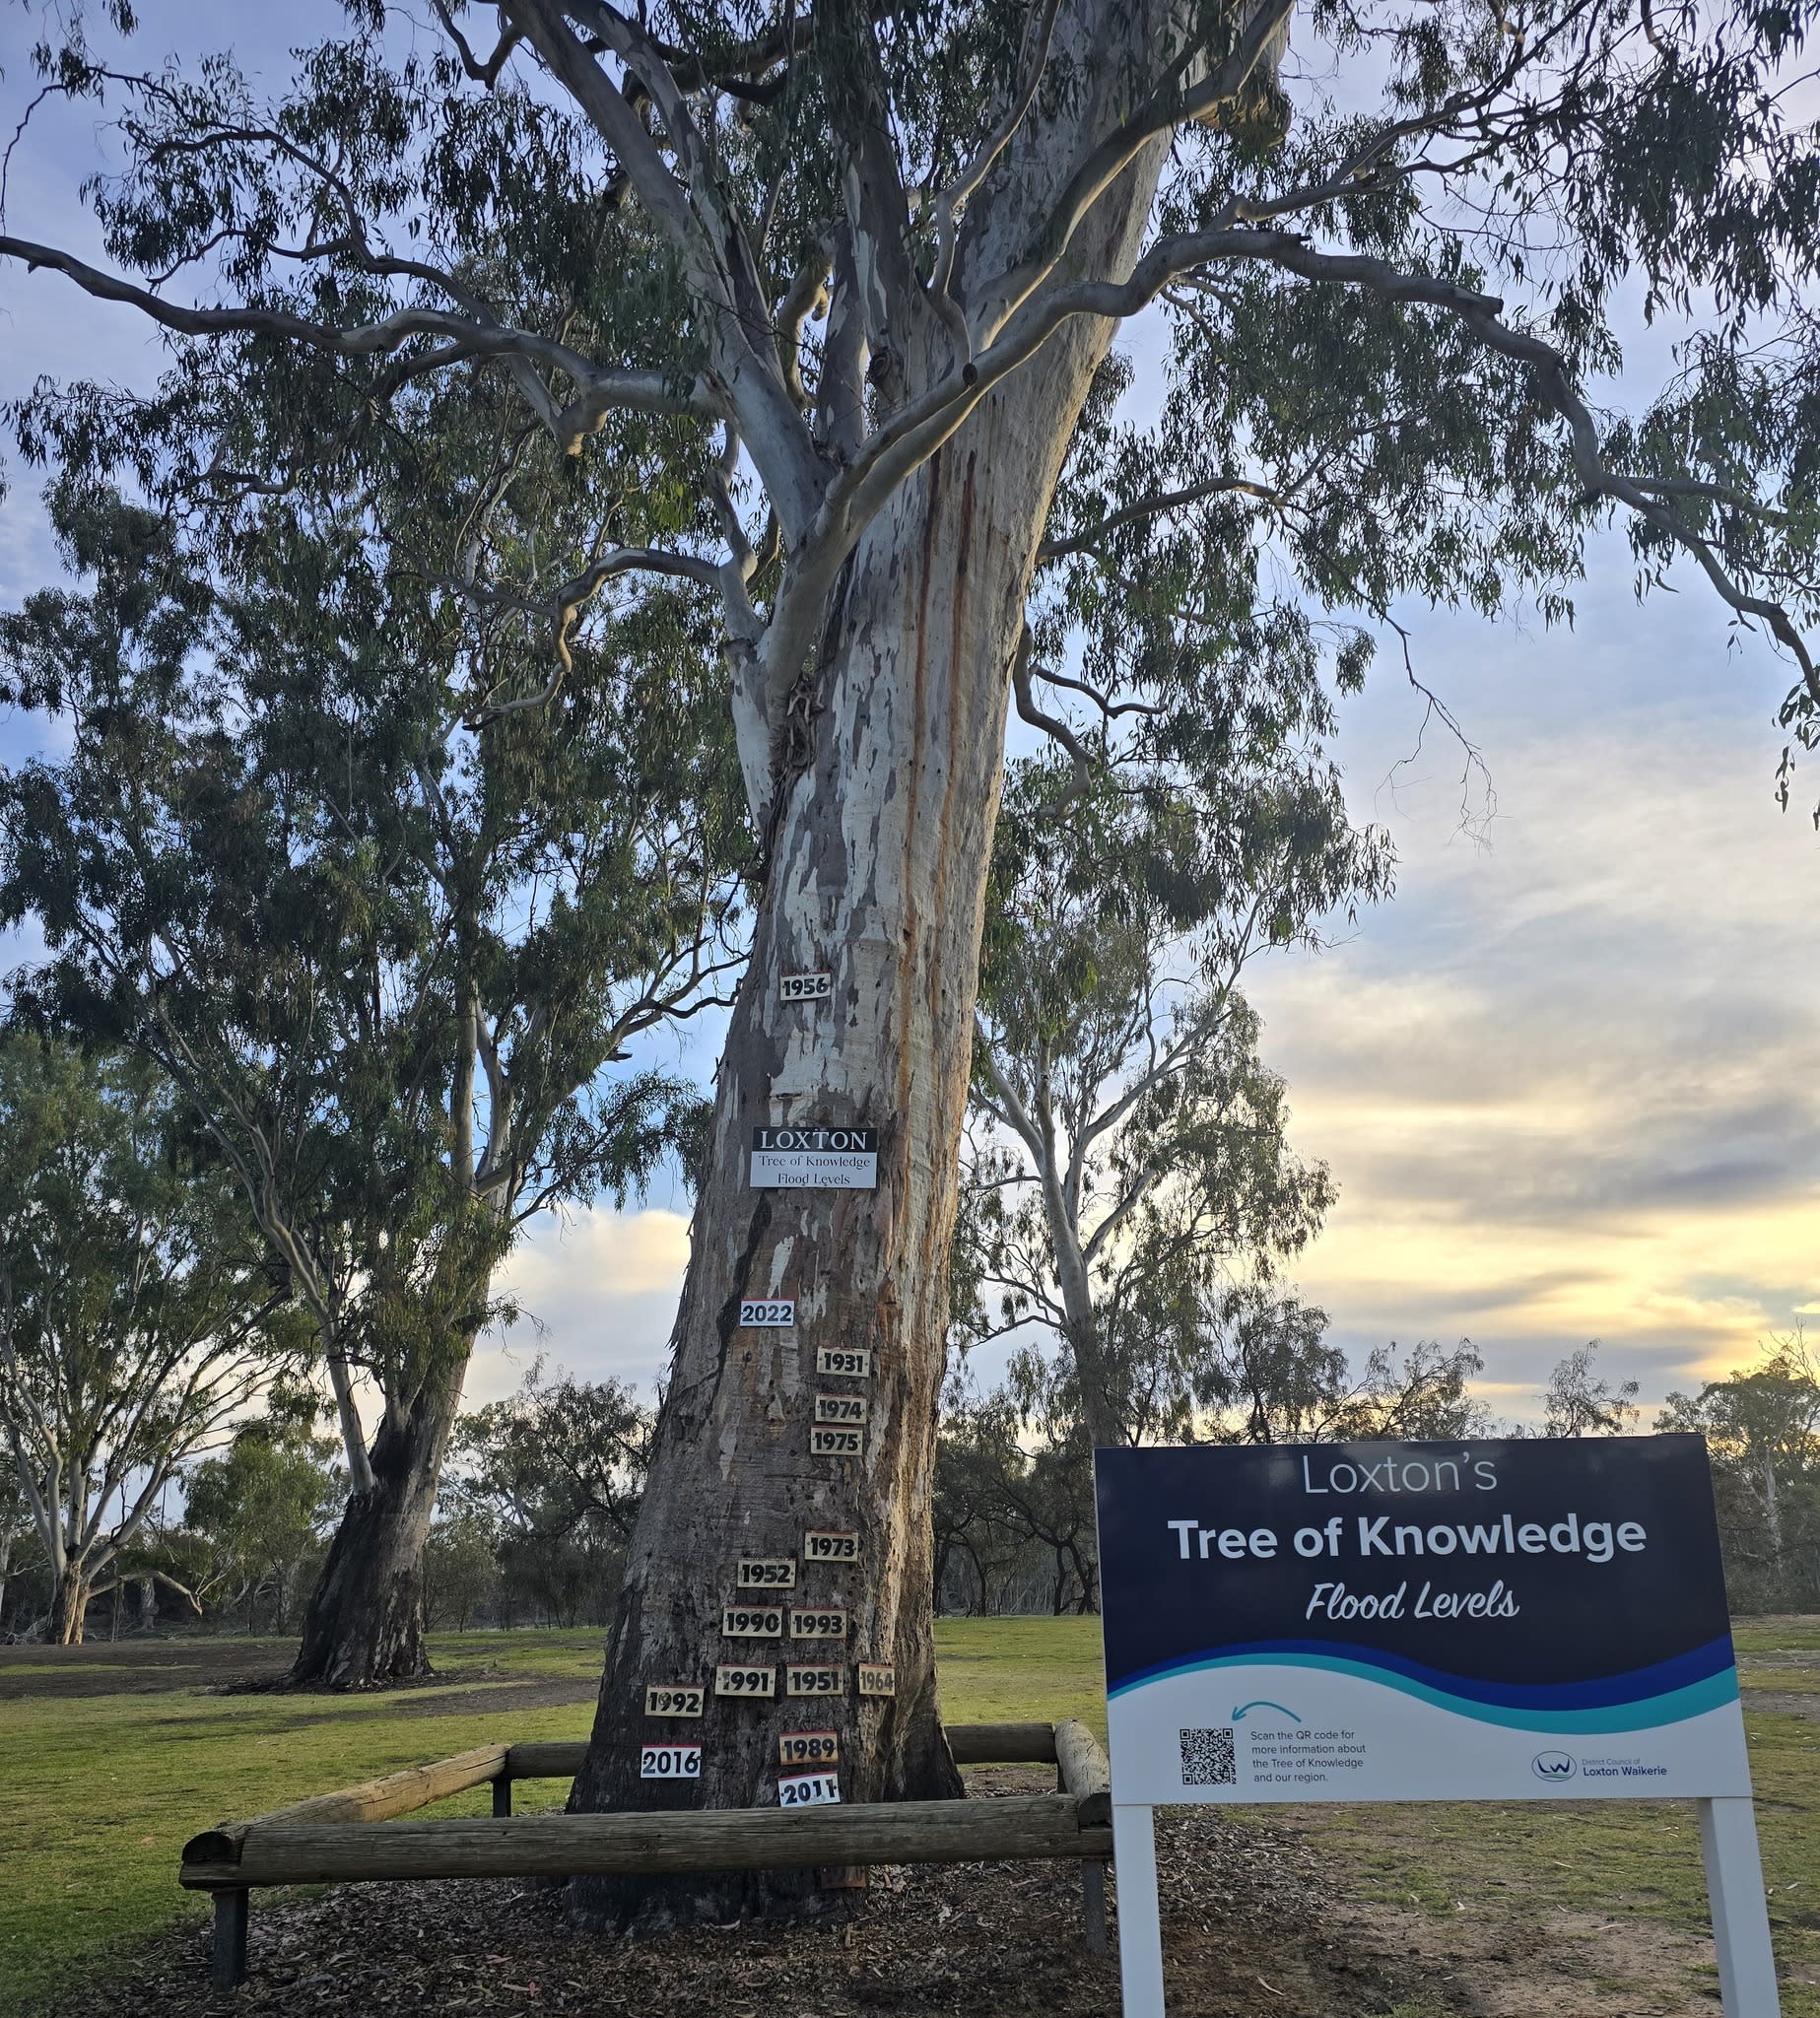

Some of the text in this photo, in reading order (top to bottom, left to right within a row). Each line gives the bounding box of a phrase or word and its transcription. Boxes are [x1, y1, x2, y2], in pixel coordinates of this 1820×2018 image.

[783, 977, 828, 996] 1956
[761, 1131, 867, 1150] LOXTON
[759, 1155, 870, 1170] Tree of Knowledge
[777, 1174, 850, 1184] Flood Levels
[742, 1305, 791, 1322] 2022
[824, 1352, 863, 1373] 1931
[820, 1400, 861, 1419] 1974
[815, 1432, 858, 1451] 1975
[810, 1537, 854, 1557] 1973
[1168, 1513, 1648, 1563] Tree of Knowledge
[742, 1564, 790, 1583] 1952
[1305, 1580, 1520, 1621] Flood Levels
[726, 1612, 779, 1633] 1990
[794, 1615, 843, 1634] 1993
[722, 1671, 769, 1691] 1991
[792, 1671, 840, 1691] 1951
[861, 1670, 893, 1690] 1964
[649, 1692, 700, 1713] 1992
[1250, 1730, 1355, 1741] Scan the QR code for
[783, 1738, 835, 1760] 1989
[1280, 1744, 1334, 1754] information
[1337, 1744, 1367, 1753] about
[642, 1751, 698, 1774] 2016
[1253, 1758, 1364, 1769] the Tree of Knowledge
[1584, 1766, 1667, 1776] Loxton Waikerie
[1254, 1773, 1328, 1783] and our region.
[784, 1779, 836, 1804] 2011
